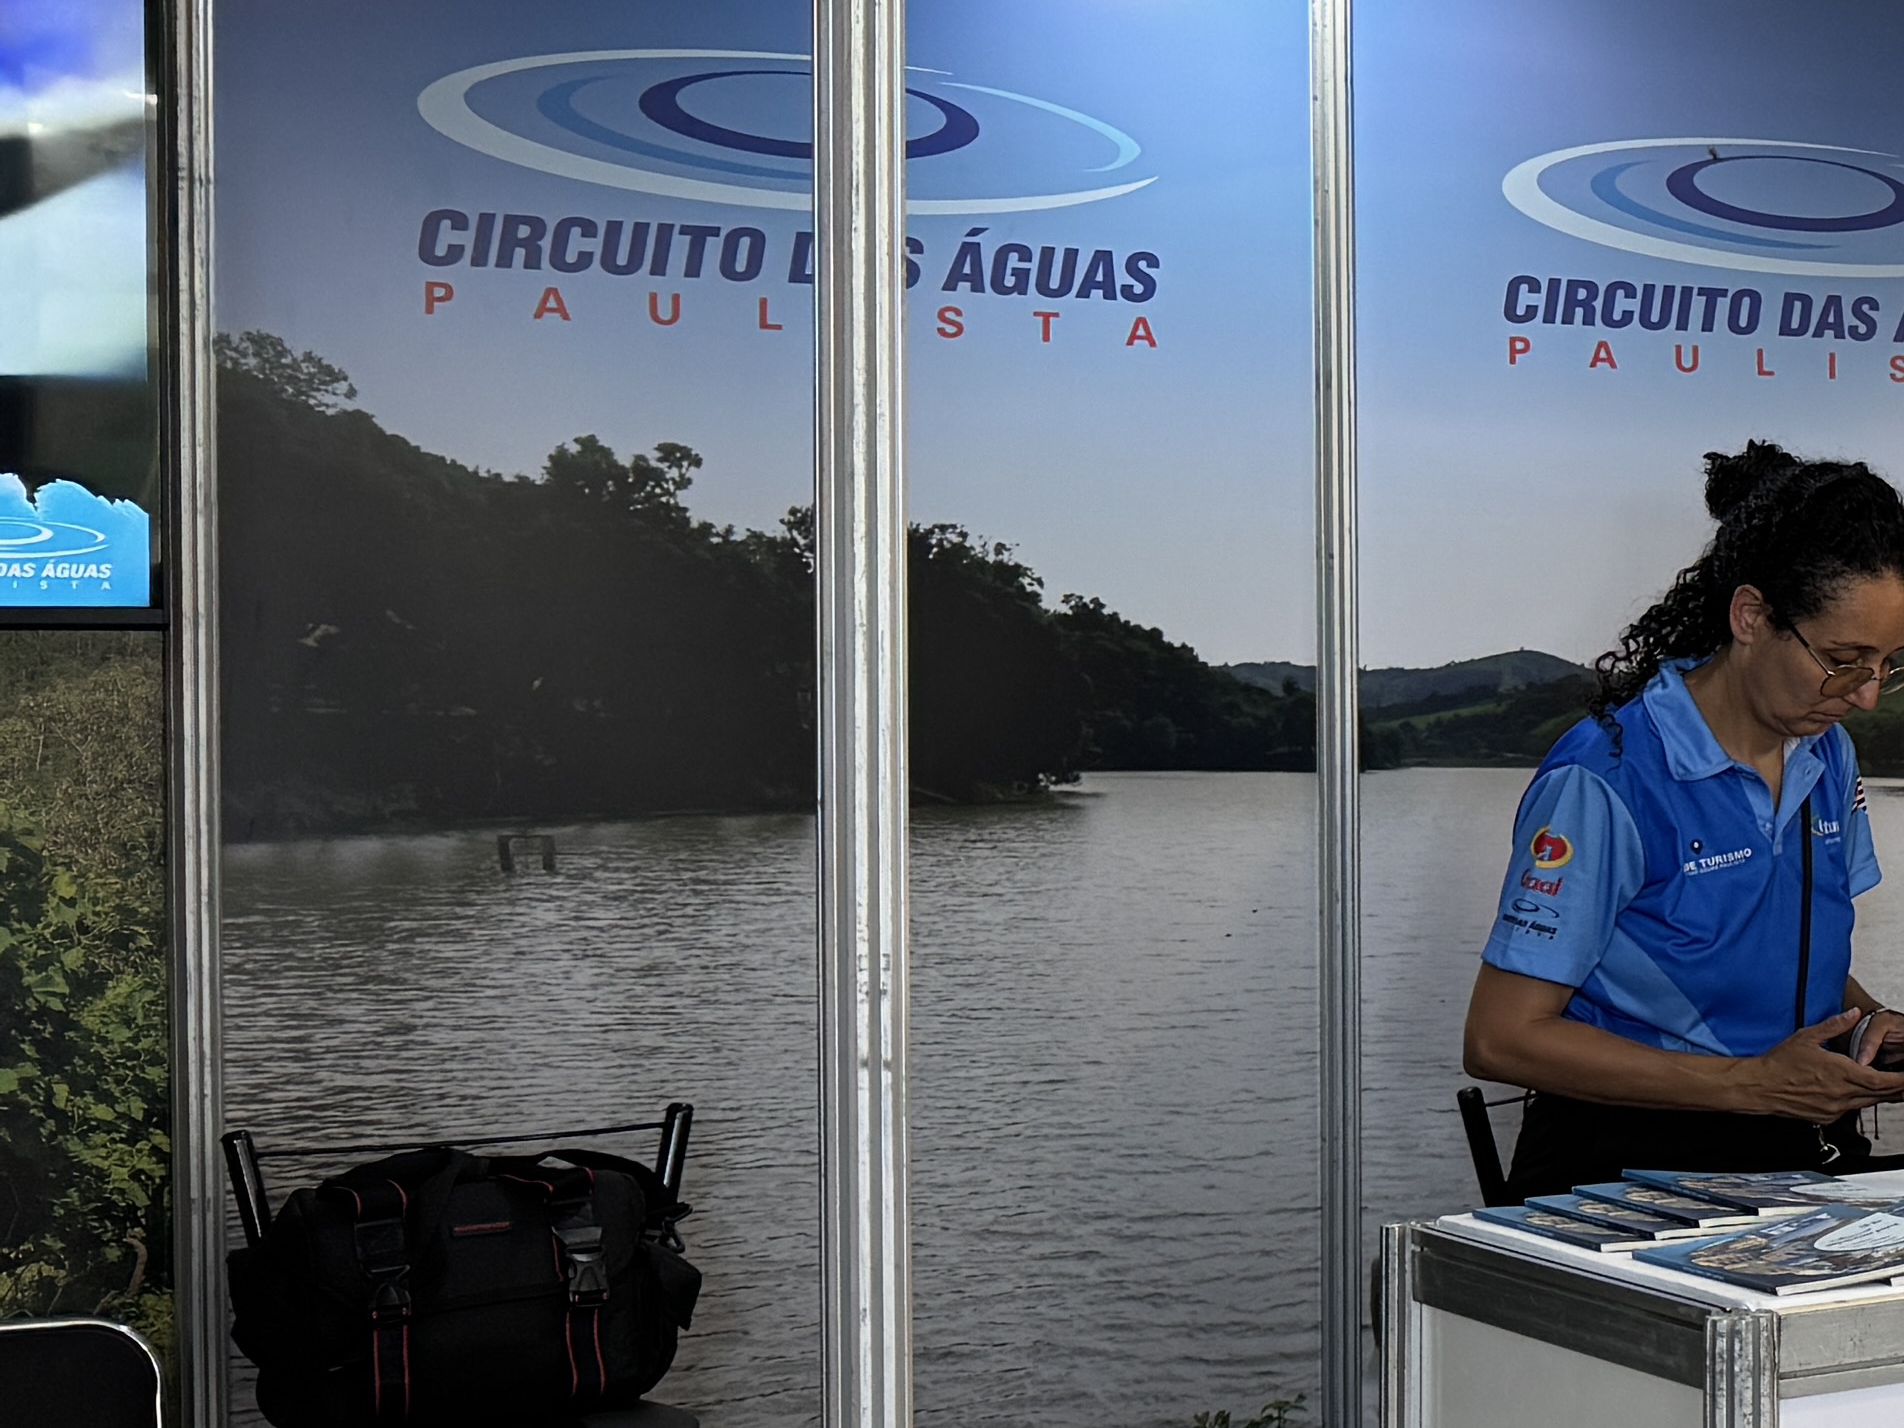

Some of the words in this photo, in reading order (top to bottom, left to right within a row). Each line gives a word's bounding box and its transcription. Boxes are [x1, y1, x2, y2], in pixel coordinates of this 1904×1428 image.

[418, 208, 765, 283] CIRCUITO
[942, 227, 1160, 302] ÁGUAS
[424, 281, 1158, 348] PAULSTA
[1503, 275, 1762, 336] CIRCUITO
[1779, 292, 1880, 342] DAS
[13, 579, 111, 590] ISTA
[41, 559, 112, 578] ÁGUAS
[1698, 847, 1752, 868] TURISMO
